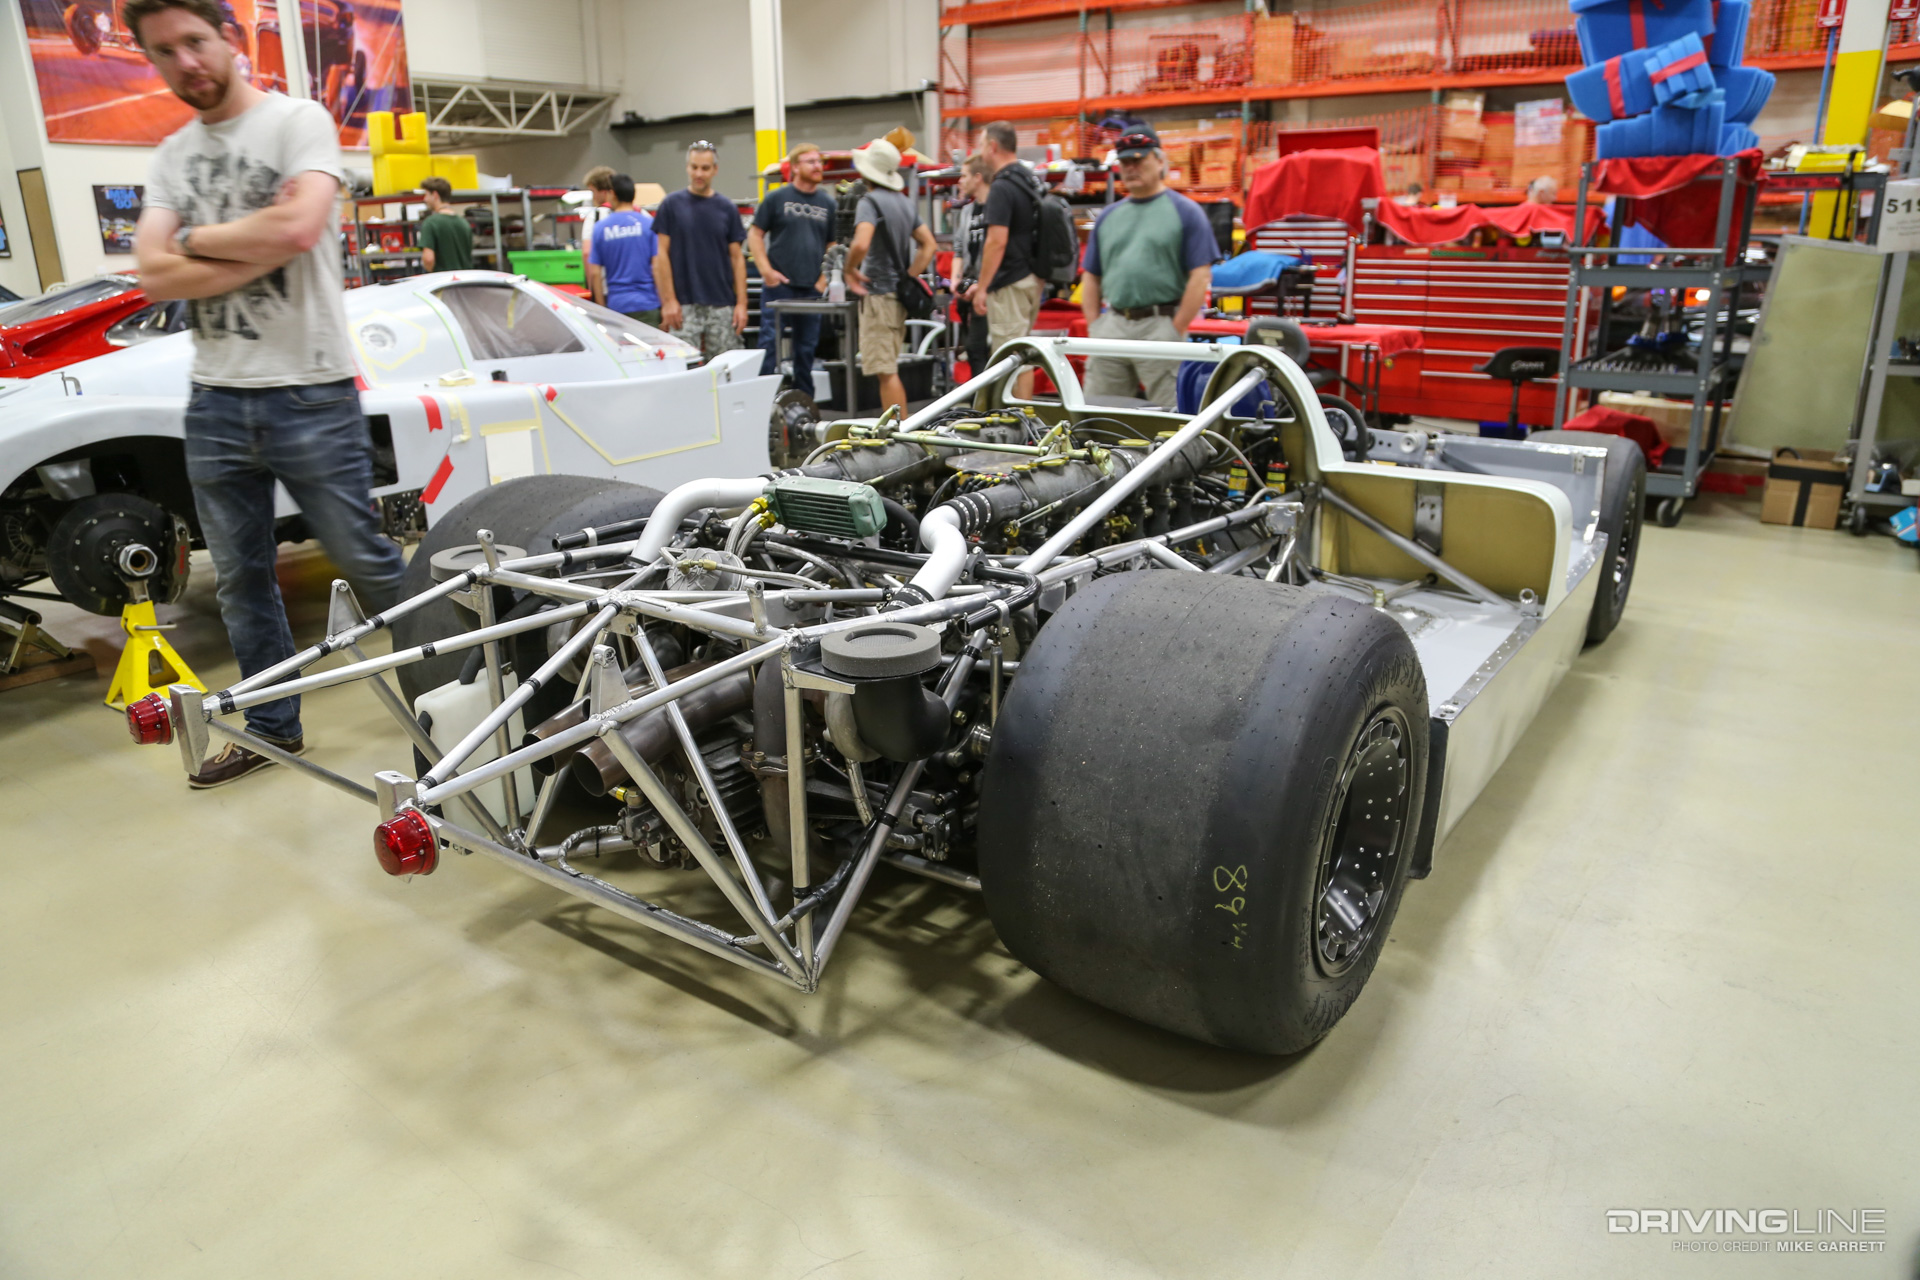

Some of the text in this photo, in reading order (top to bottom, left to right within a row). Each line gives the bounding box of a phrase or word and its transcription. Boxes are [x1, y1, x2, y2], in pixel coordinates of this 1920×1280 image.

[783, 201, 828, 221] FOOSE
[1886, 198, 1920, 213] 51
[604, 221, 642, 241] Maui
